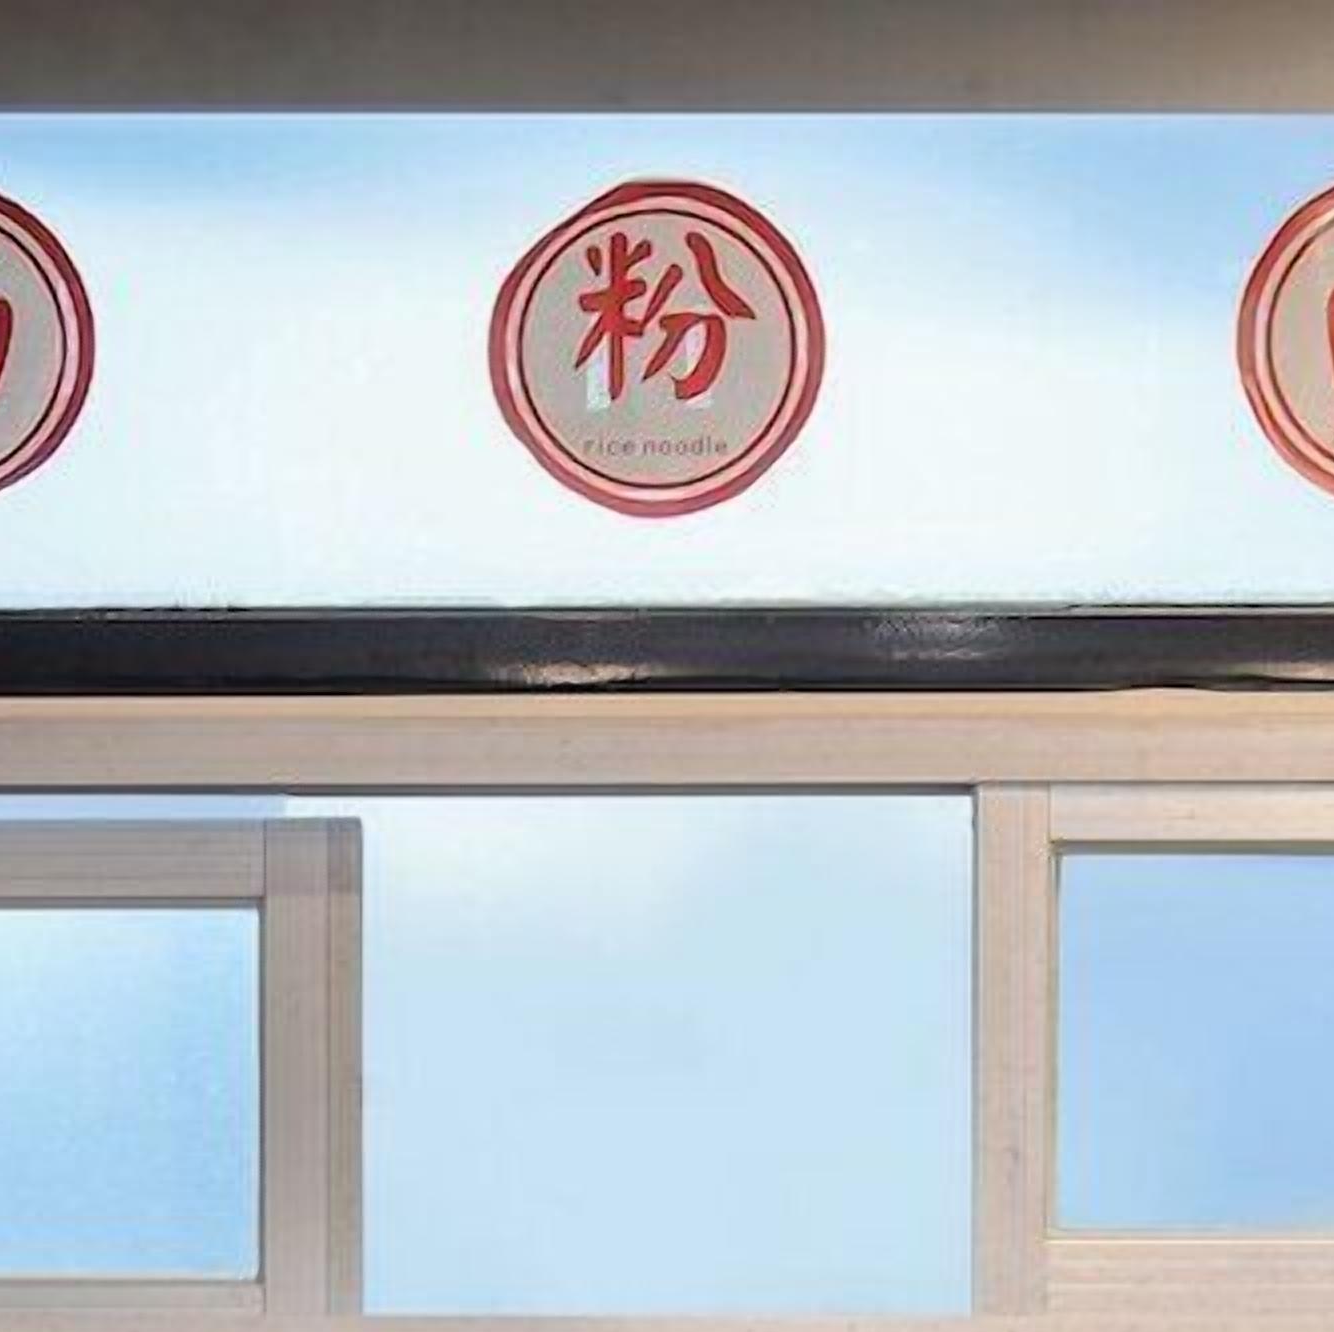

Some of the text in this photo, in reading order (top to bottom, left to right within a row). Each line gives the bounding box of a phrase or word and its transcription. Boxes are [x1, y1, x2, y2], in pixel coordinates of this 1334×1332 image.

[574, 231, 756, 401] 粉
[583, 434, 728, 456] rice noodle
